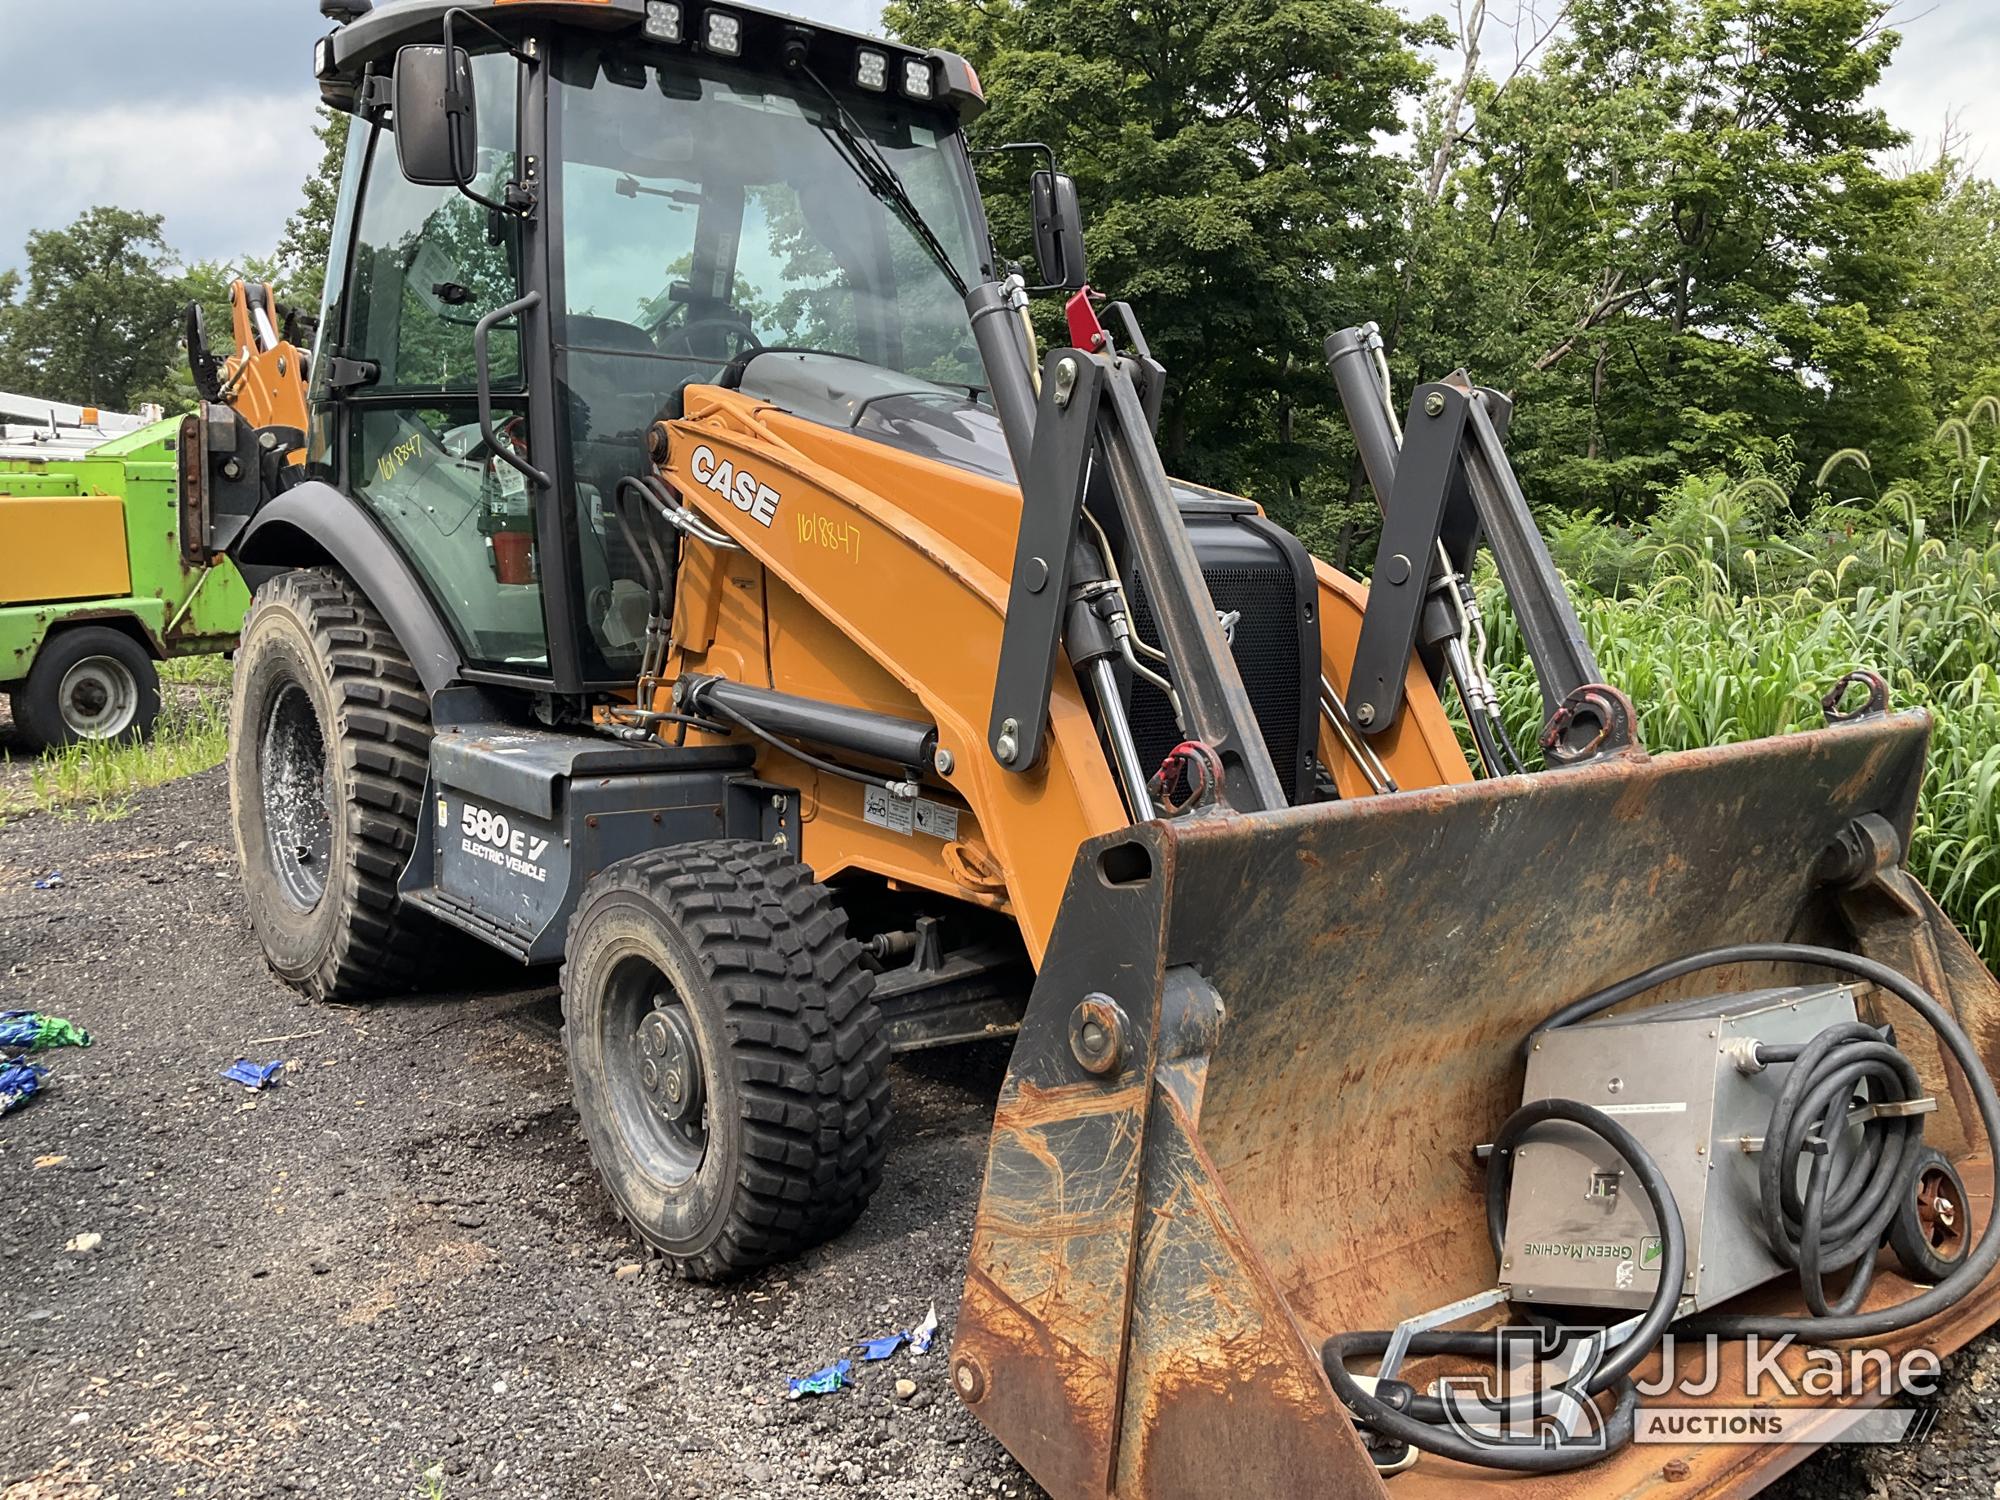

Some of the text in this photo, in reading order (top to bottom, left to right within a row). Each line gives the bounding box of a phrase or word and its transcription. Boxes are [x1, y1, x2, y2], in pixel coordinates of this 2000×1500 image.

[377, 433, 422, 482] 1618847
[690, 445, 782, 528] CASE
[797, 512, 861, 564] 1618847
[461, 838, 547, 883] ELECTRIC VEHICLE
[1524, 1243, 1634, 1260] GREEN MACHINE
